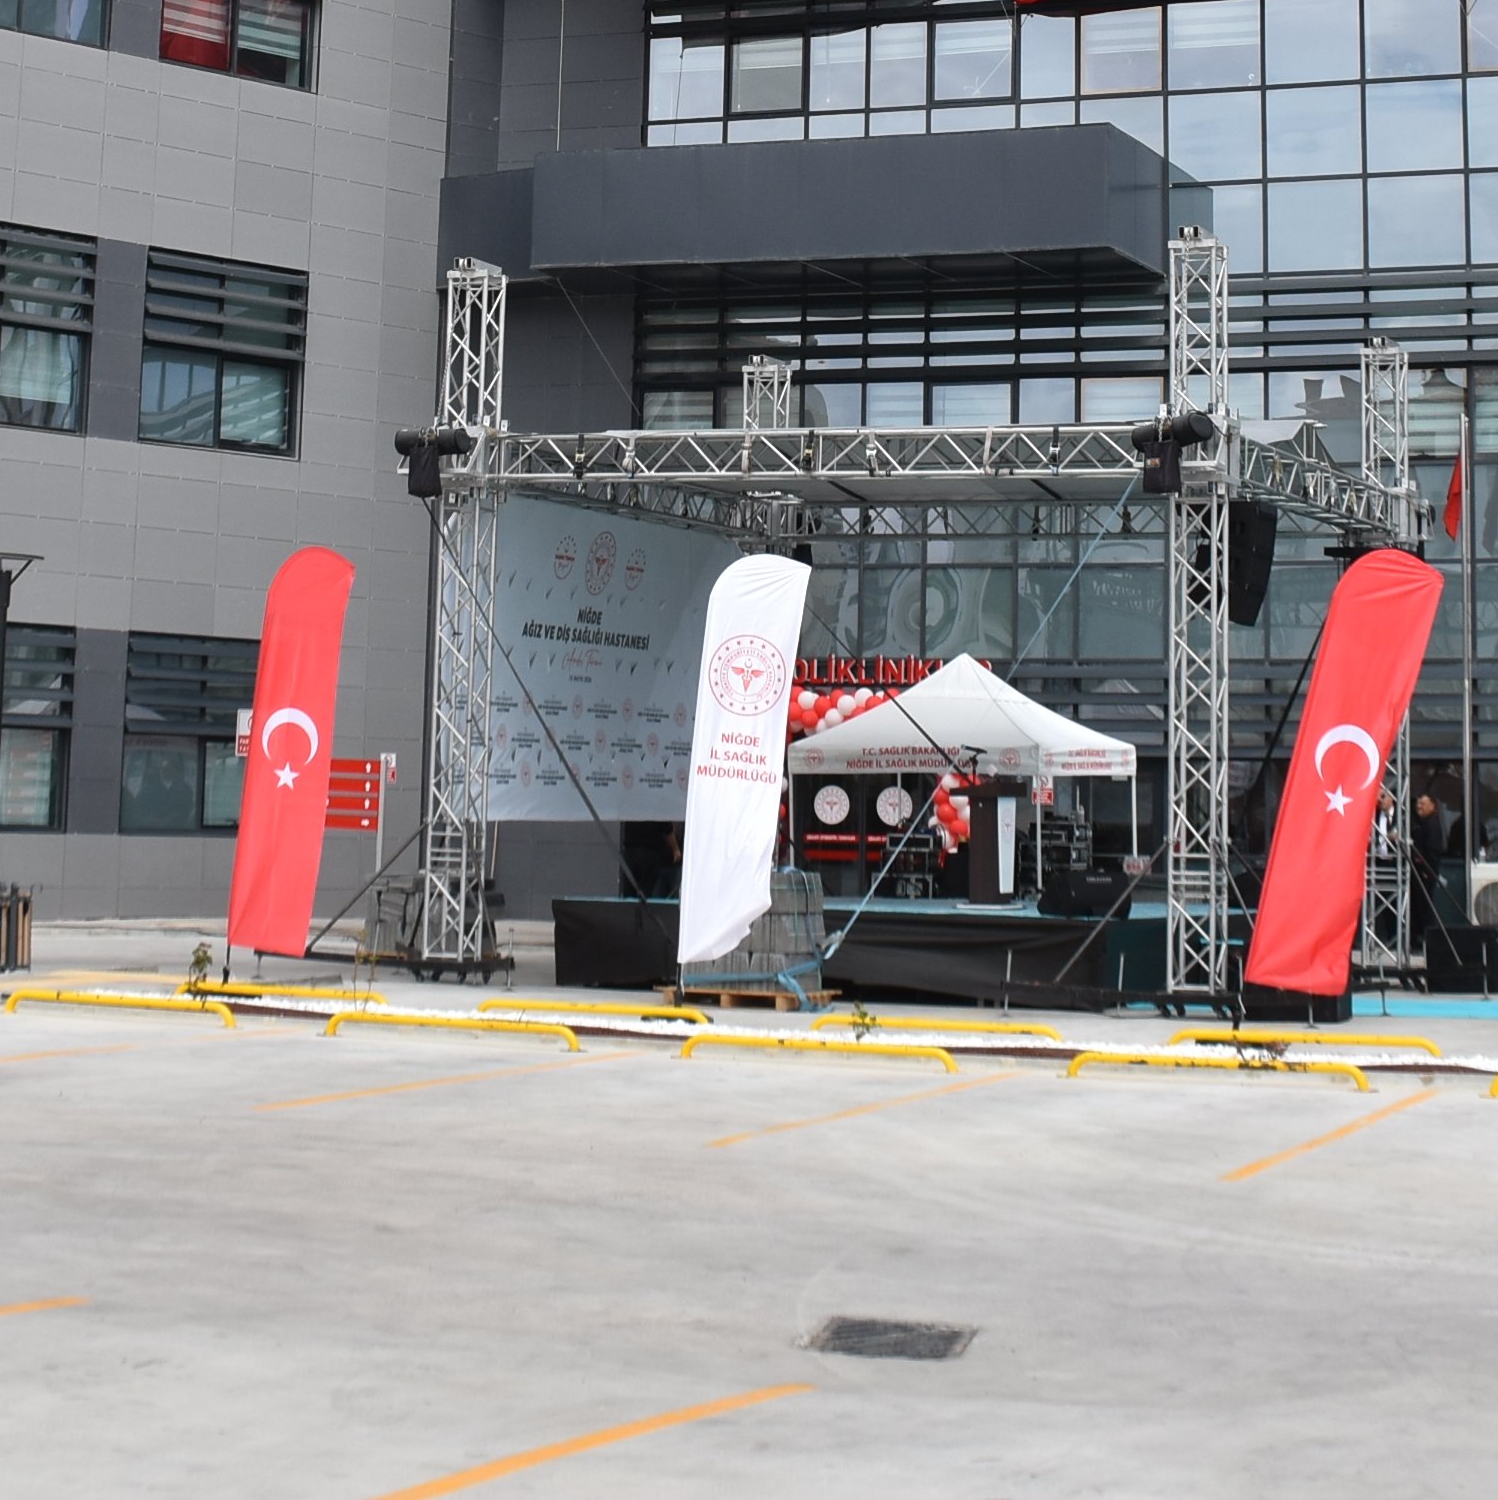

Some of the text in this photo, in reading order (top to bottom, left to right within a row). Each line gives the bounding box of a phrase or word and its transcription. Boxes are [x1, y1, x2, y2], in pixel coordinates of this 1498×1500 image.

[577, 606, 602, 625] NİĞDE
[522, 619, 650, 650] AĞIZ VE DİŞ SAĞLIĞI HASTANESİ
[721, 732, 760, 747] NİĞDE
[710, 746, 767, 765] İL SAĞLIK
[862, 747, 877, 756] T.C.
[879, 745, 910, 756] SAĞLIK
[846, 758, 873, 769] NİĞDE
[876, 758, 883, 768] İL
[885, 758, 916, 768] SAĞLIK
[696, 764, 777, 784] MÜDÜRLÜĞÜ
